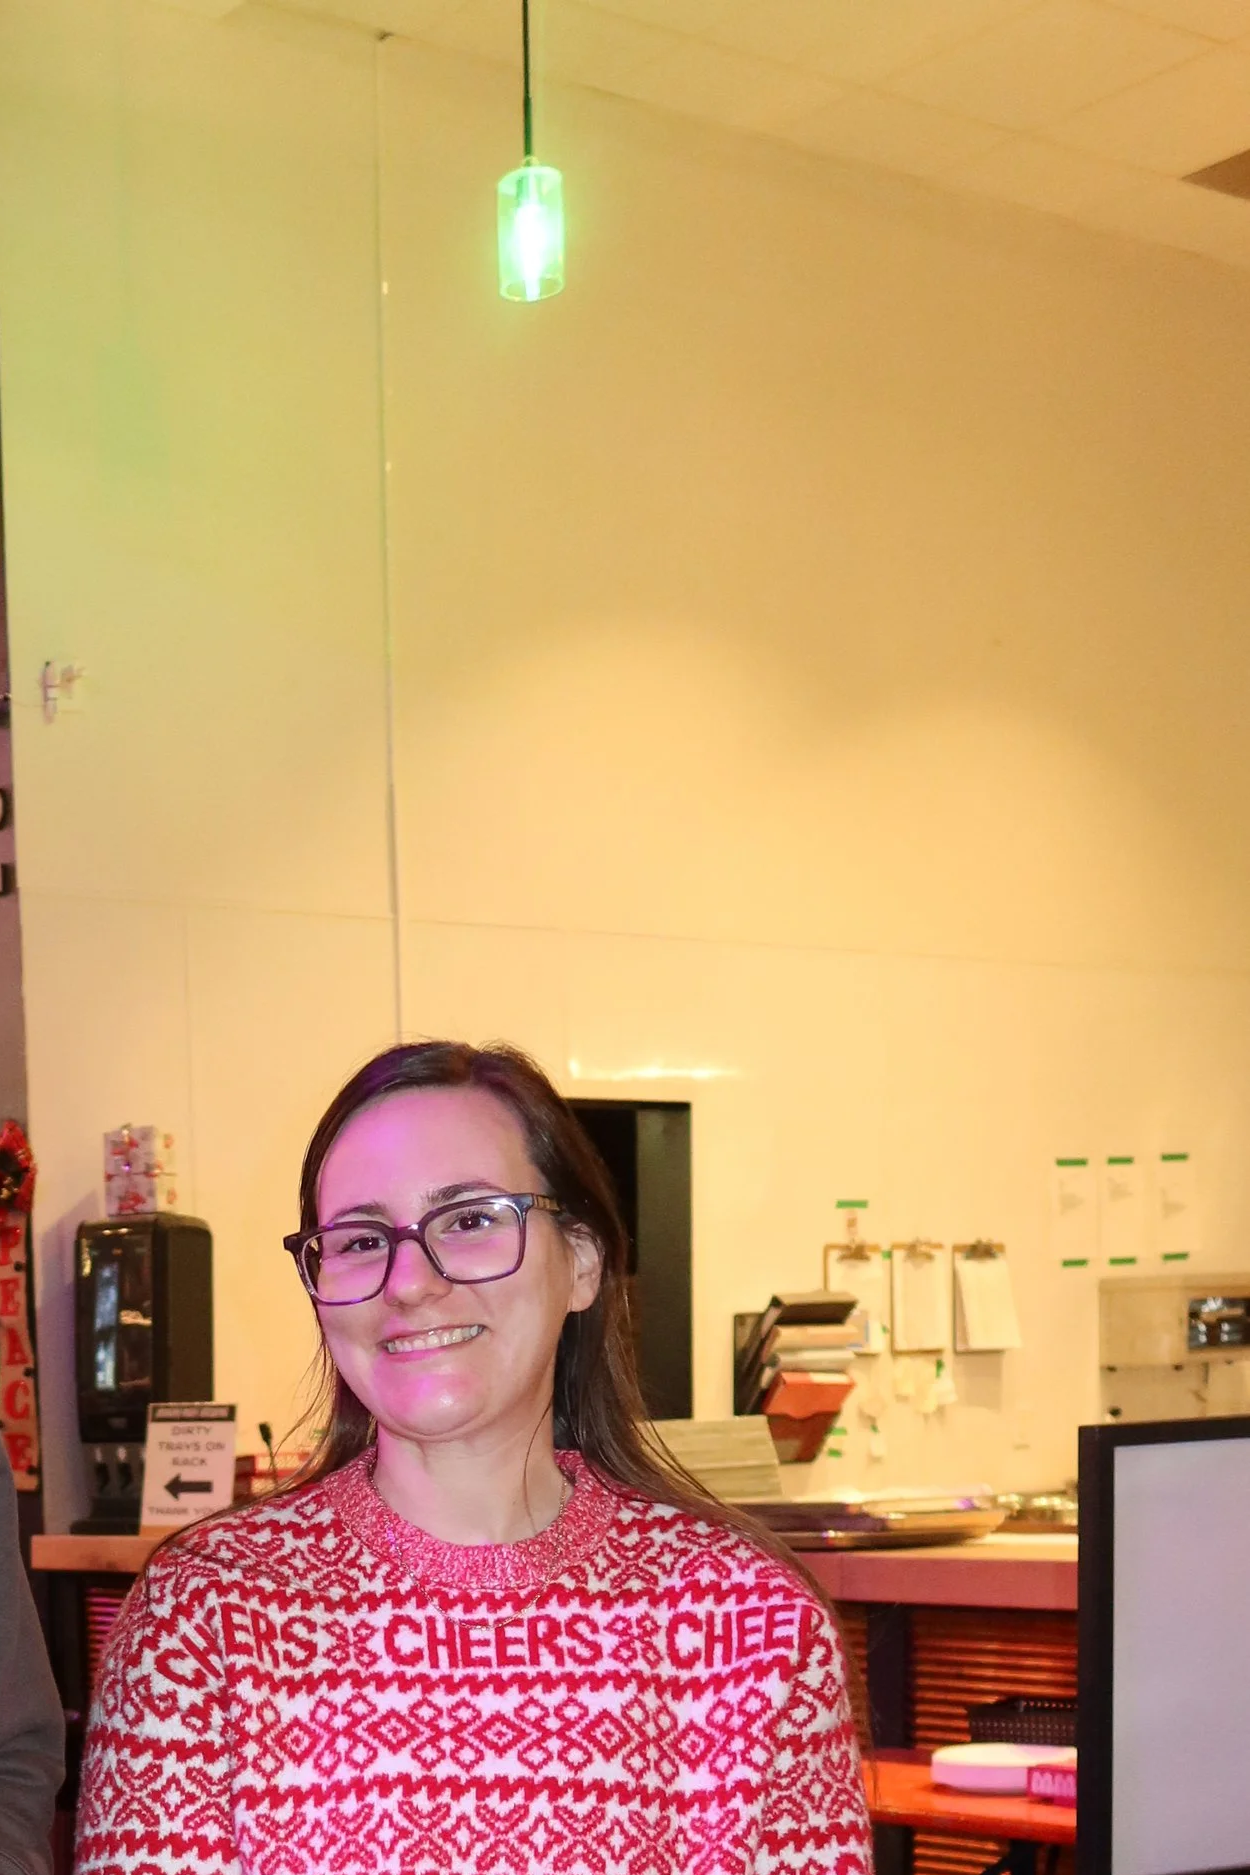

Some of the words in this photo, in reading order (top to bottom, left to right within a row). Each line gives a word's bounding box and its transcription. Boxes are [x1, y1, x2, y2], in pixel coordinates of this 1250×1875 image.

[171, 1426, 211, 1436] DIRTY
[158, 1441, 201, 1452] TRAYS
[206, 1442, 225, 1452] ON
[148, 1507, 188, 1516] THANK
[384, 1613, 603, 1669] CHEERS
